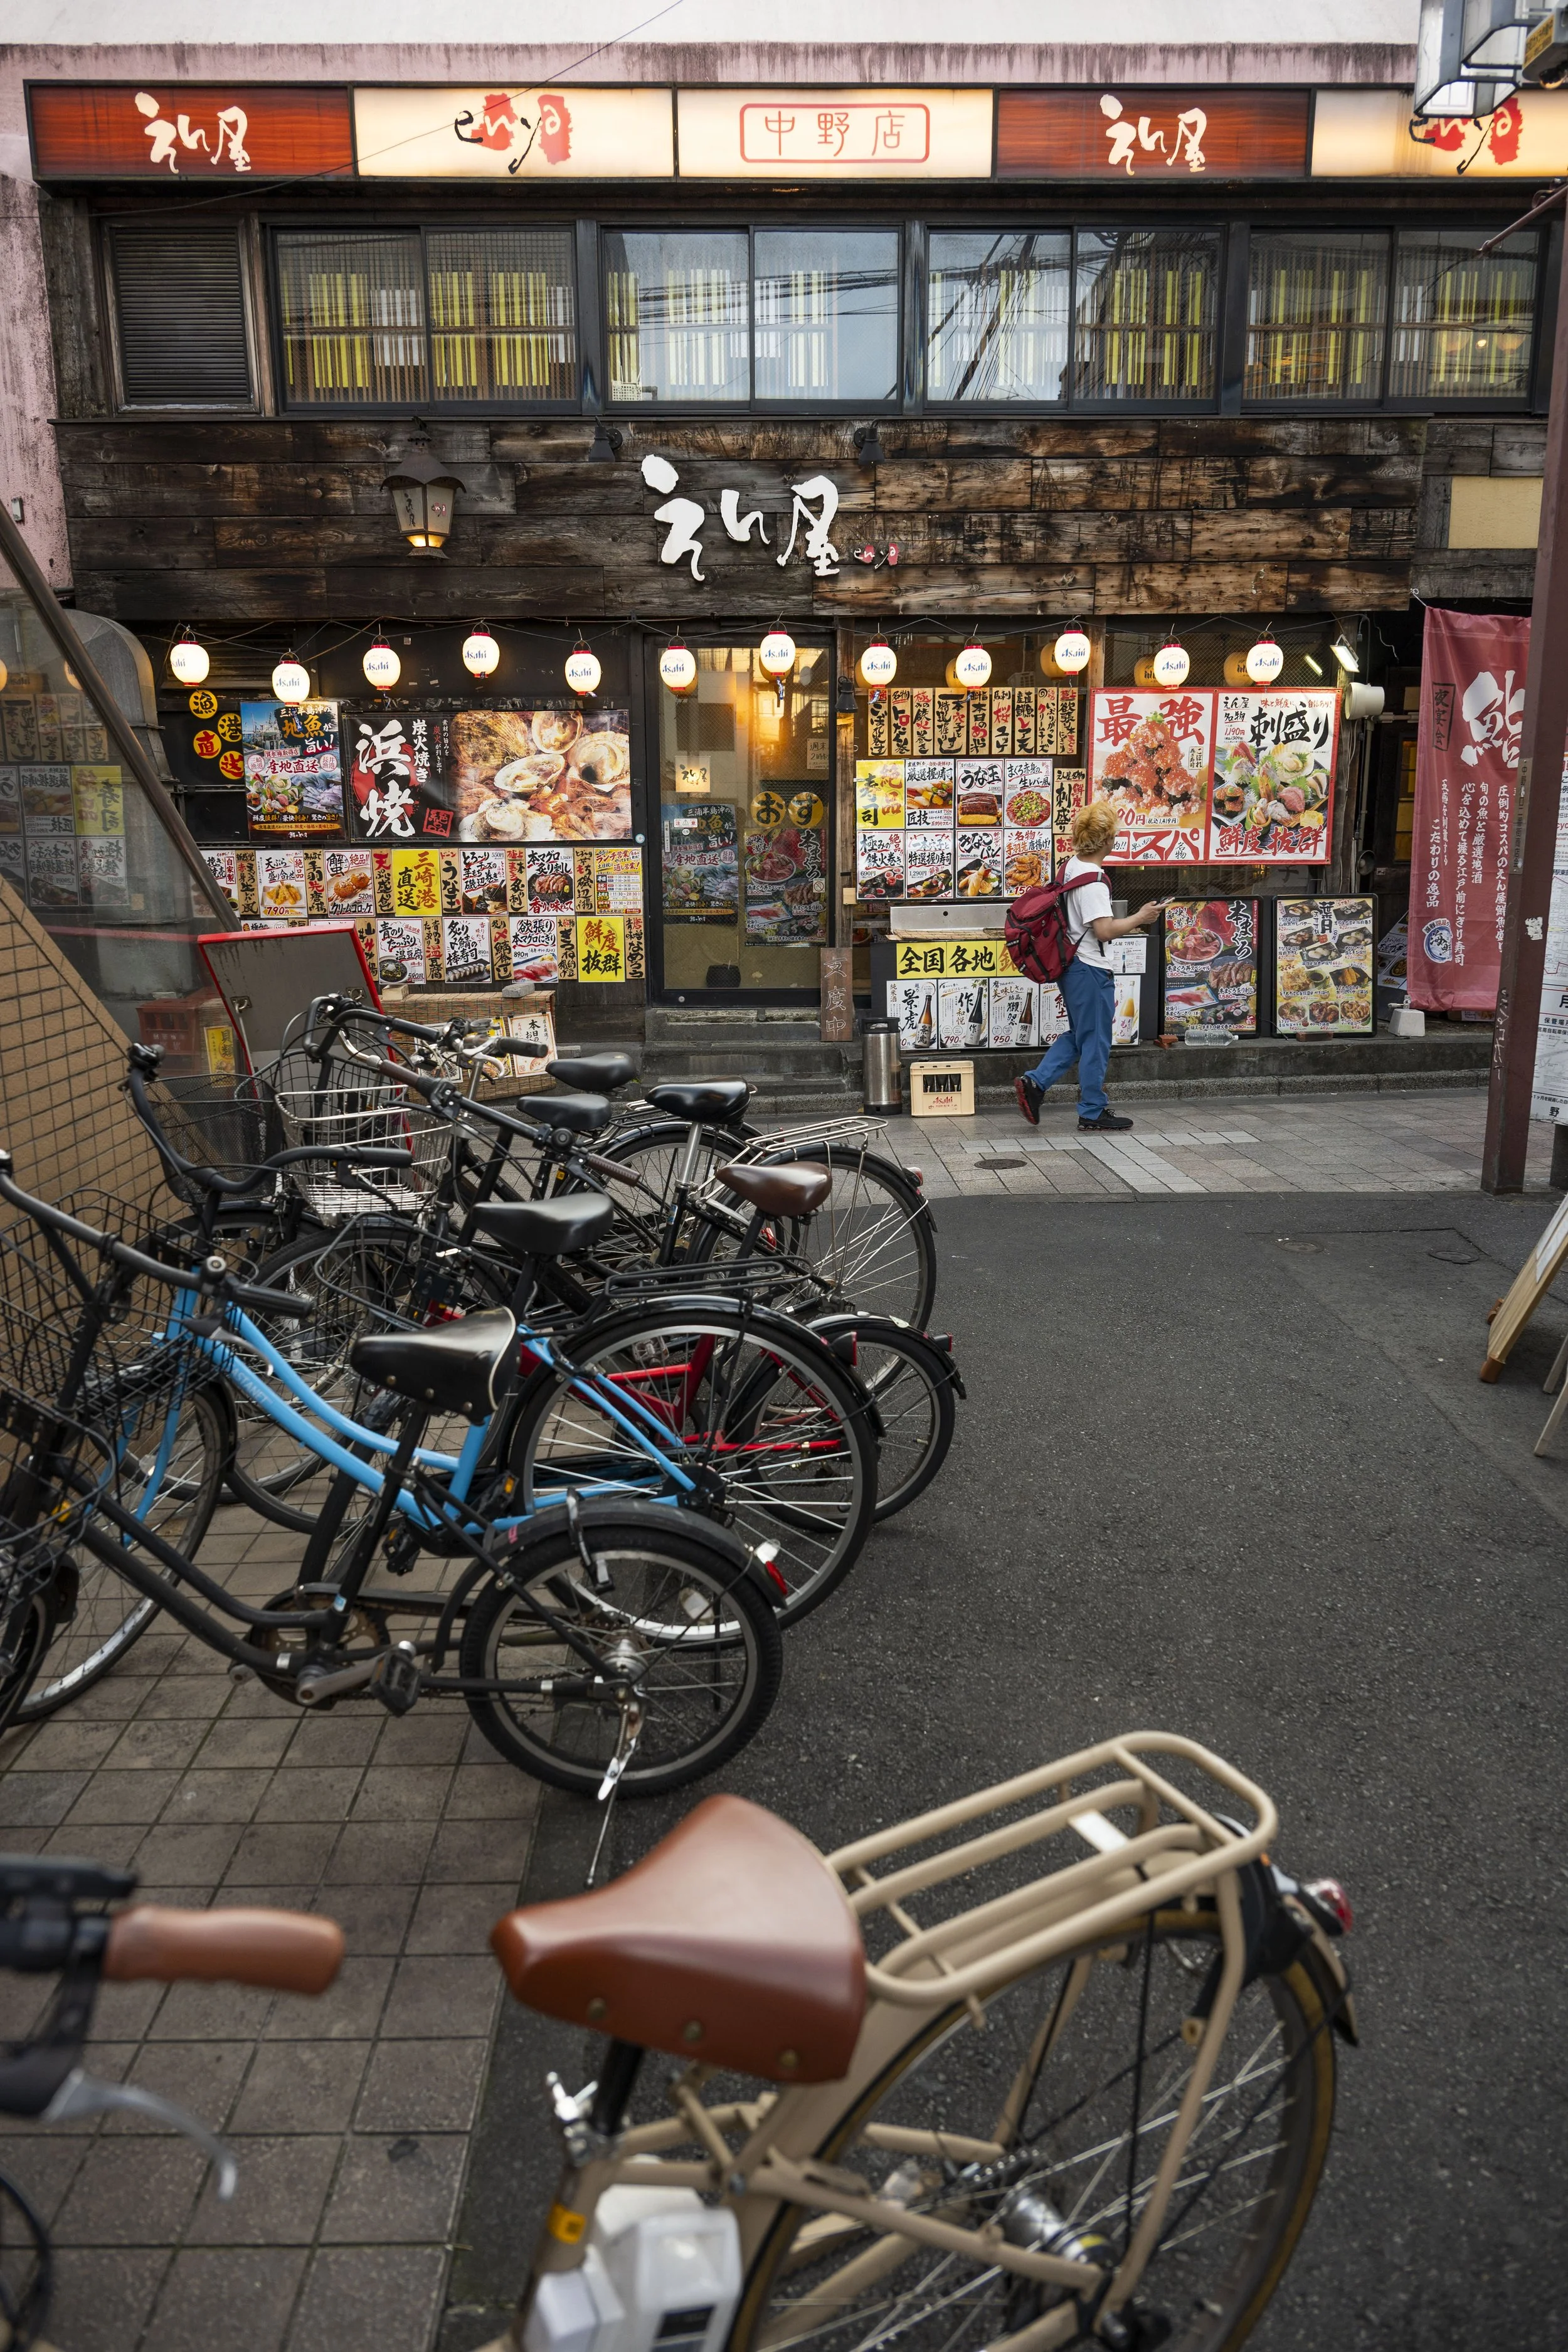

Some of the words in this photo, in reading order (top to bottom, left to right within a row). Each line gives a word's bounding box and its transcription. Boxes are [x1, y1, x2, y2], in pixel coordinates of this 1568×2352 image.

[765, 110, 906, 157] 中野店
[640, 454, 840, 582] えん屋
[765, 649, 788, 658] Asahi
[662, 664, 684, 673] Asahi
[867, 661, 891, 670] Asahi
[964, 662, 987, 671] Asahi
[1162, 661, 1185, 670] Asahi
[1254, 658, 1279, 667] Asahi
[569, 667, 591, 677] Asahi
[893, 691, 909, 701] 名物
[1223, 696, 1250, 709] えん屋
[1261, 697, 1295, 708] 味と鮮度に
[1096, 695, 1205, 747] 最強
[1224, 711, 1246, 722] 名物
[1224, 728, 1245, 736] 1,190円
[1248, 701, 1329, 750] 刺盛り
[442, 719, 450, 756] 素材の旨みを
[412, 719, 430, 783] 炭火焼き
[433, 725, 443, 774] 炭火が引き出す
[266, 760, 319, 774] 産地直送
[907, 766, 953, 781] 厳選握り寿司
[1007, 762, 1041, 777] まぐろ赤身の
[356, 719, 415, 837] 浜焼
[961, 765, 1002, 790] うな玉
[1019, 776, 1051, 790] 生レバー風
[687, 805, 731, 817] 三浦半島沖の
[1054, 782, 1073, 833] 刺盛り
[907, 810, 931, 827] 匠技
[1014, 830, 1036, 841] 名物
[1215, 822, 1324, 857] 鮮度抜群
[1471, 781, 1489, 884] 旬の魚と厳選地酒
[860, 834, 891, 852] 極みの
[1005, 840, 1029, 857] 手羽先
[1029, 837, 1051, 851] 唐揚げ!
[1106, 827, 1200, 861] コスパ
[1175, 842, 1187, 859] 名物
[527, 850, 561, 865] 本マグロ
[673, 852, 720, 866] 産地直送
[864, 852, 902, 867] 鉄火巻き
[908, 850, 952, 866] 特選握り寿司
[980, 846, 1002, 859] パン
[226, 858, 235, 882] 自家製
[265, 857, 287, 870] 天ぷら
[295, 859, 304, 879] 絶品
[326, 852, 345, 877] 蟹
[535, 862, 571, 875] 炙り刺し
[414, 850, 438, 908] 三崎港
[1454, 782, 1476, 967] 心を込めて握る江戸前にぎり寿司
[396, 867, 421, 911] 直送
[267, 906, 290, 915] 790円
[529, 897, 574, 914] 香りも味わって
[518, 918, 553, 933] 欲張り
[1318, 901, 1335, 934] 葉月
[379, 921, 404, 939] 青のり
[448, 919, 469, 939] 炙り
[584, 919, 620, 953] 鮮度
[1226, 899, 1254, 960] 本まぐろ
[387, 935, 416, 951] たっぷり
[512, 933, 556, 946] 本マグロにぎり
[395, 948, 423, 961] 温豆腐
[446, 948, 478, 966] 棒寿司
[582, 950, 622, 977] 抜群
[824, 956, 847, 1039] 支度中
[992, 985, 1024, 999] 美味しさの
[899, 988, 920, 1031] 景虎
[958, 992, 973, 1013] 作
[933, 1096, 953, 1104] Asahi
[1549, 1106, 1560, 1118] 野
